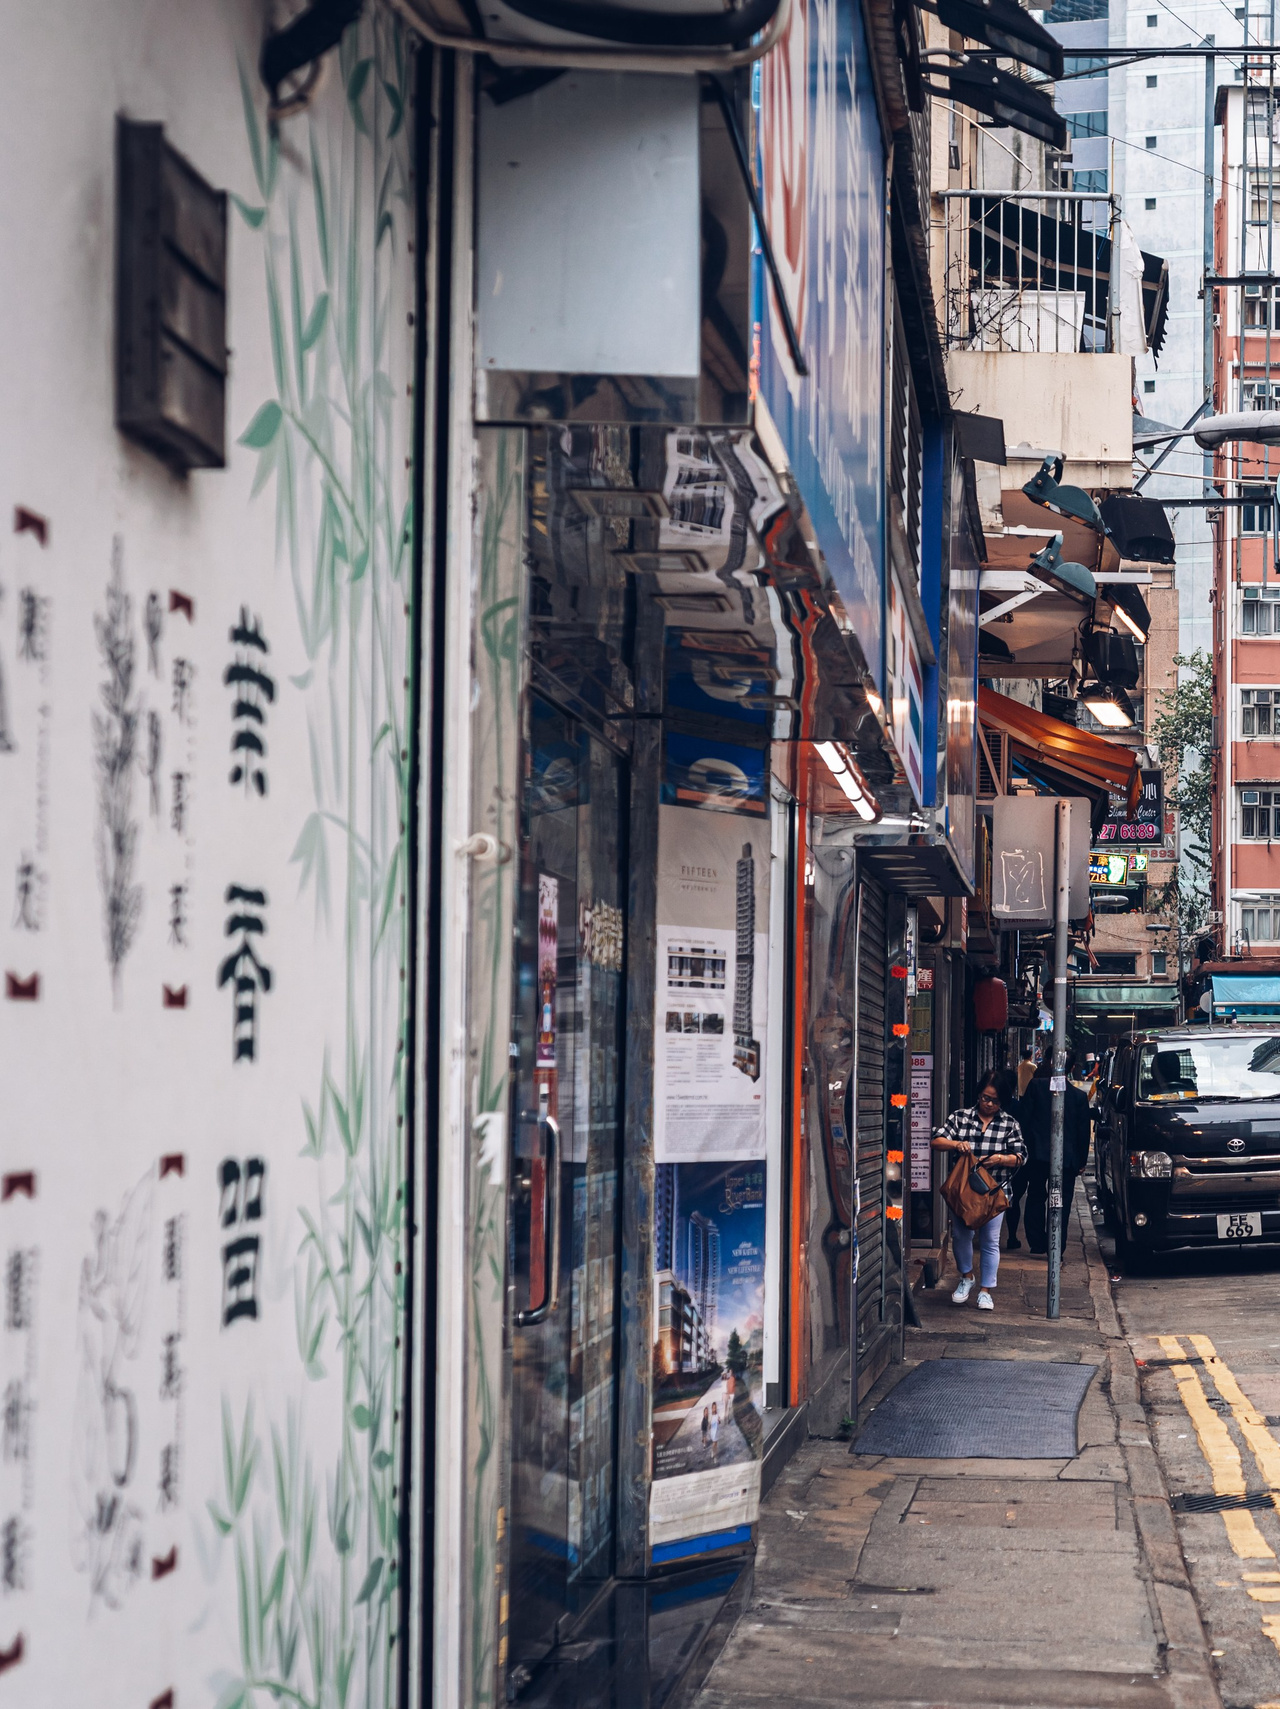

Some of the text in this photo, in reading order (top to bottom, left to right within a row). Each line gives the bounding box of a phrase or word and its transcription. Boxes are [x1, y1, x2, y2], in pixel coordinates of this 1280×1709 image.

[1120, 823, 1156, 840] 6889
[681, 865, 717, 878] FIFTEEN
[1230, 1214, 1248, 1227] EE
[1226, 1225, 1254, 1238] 669
